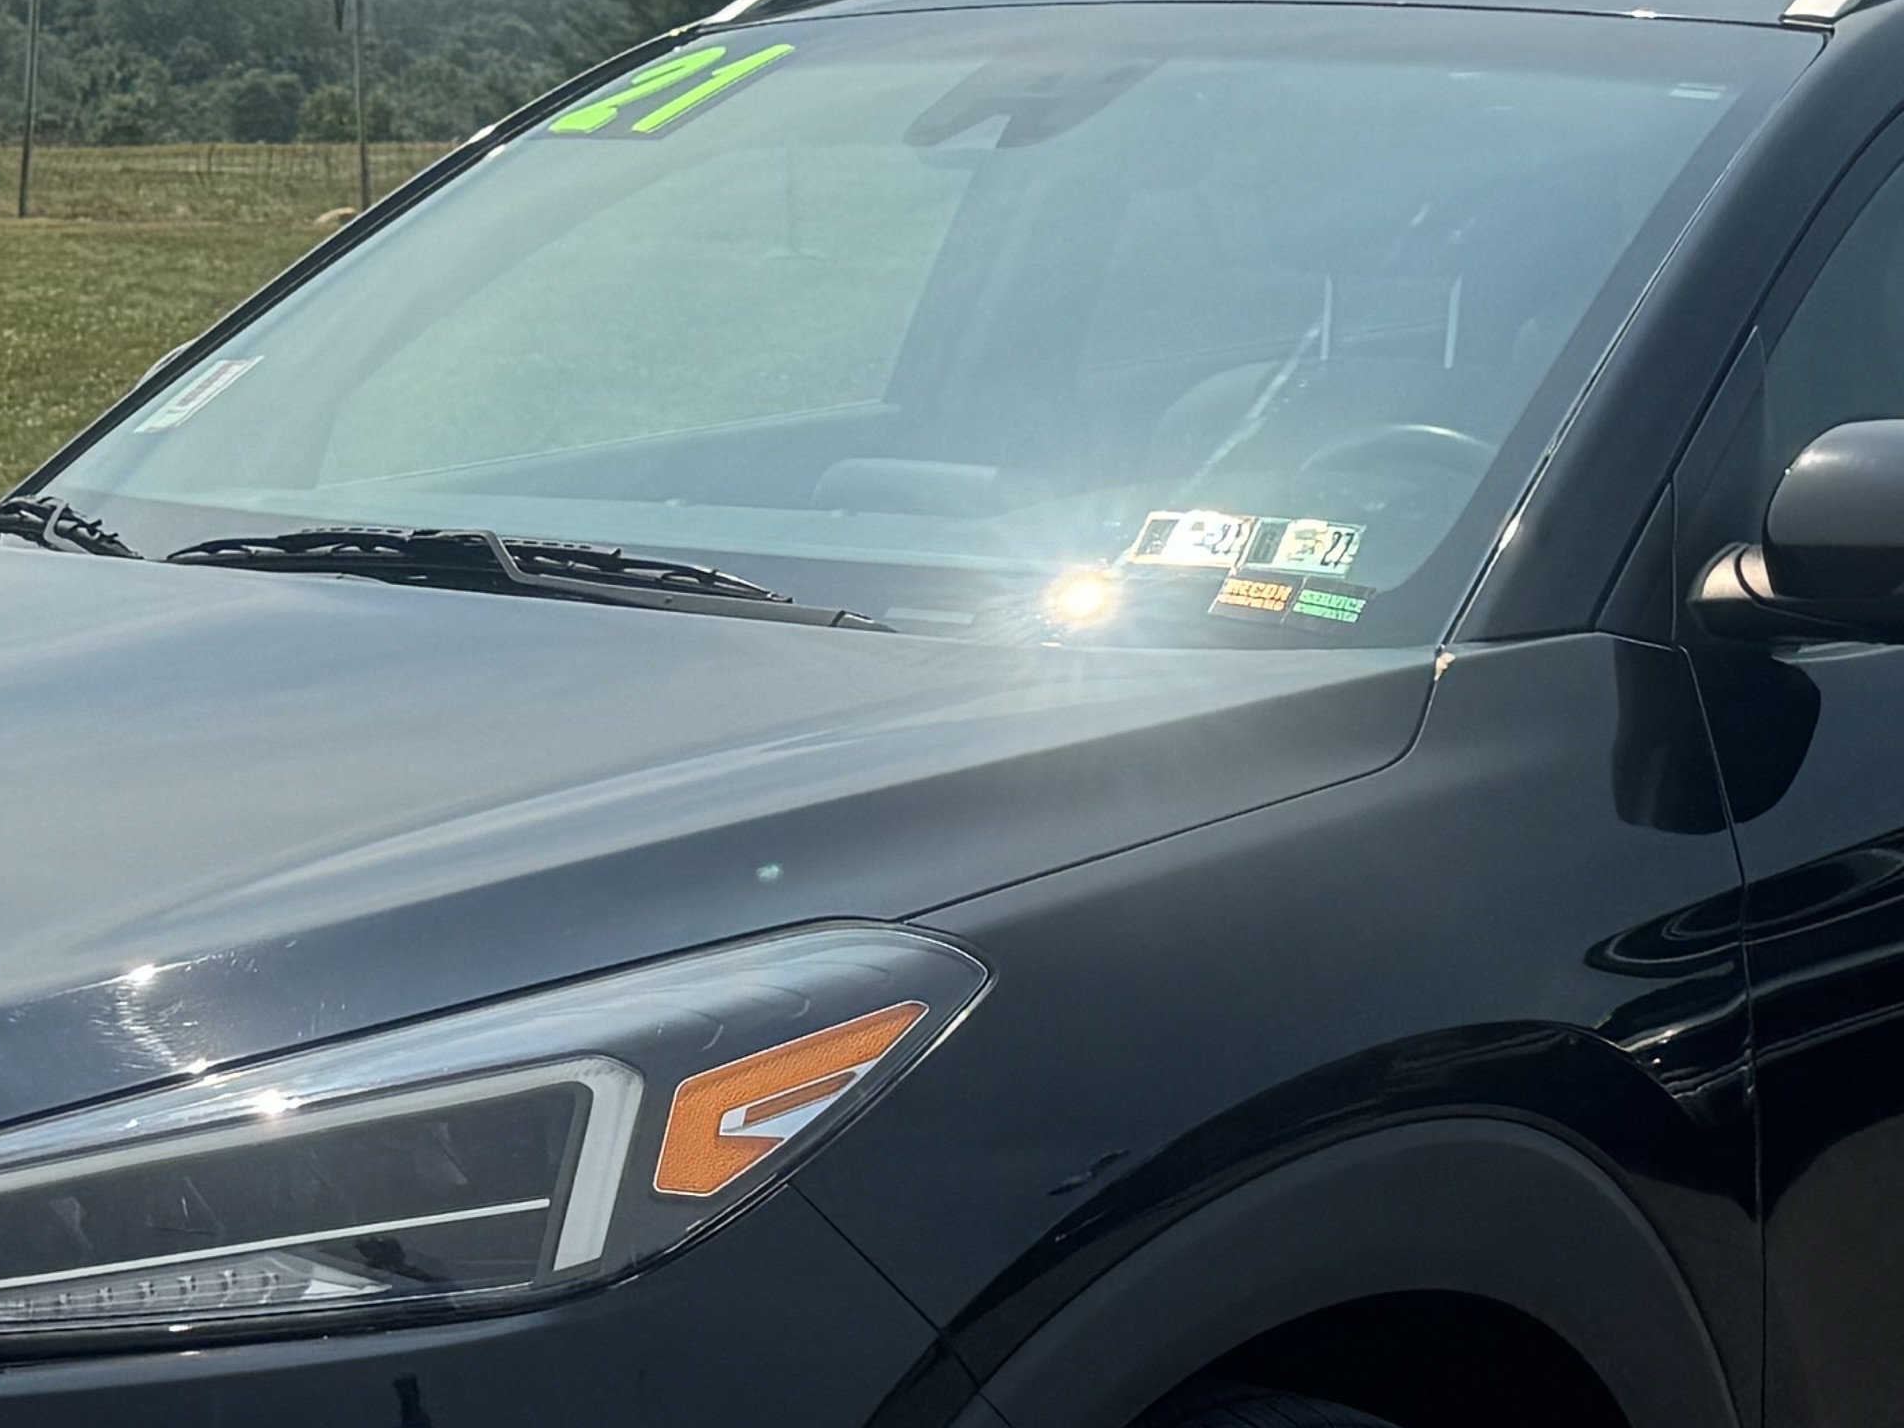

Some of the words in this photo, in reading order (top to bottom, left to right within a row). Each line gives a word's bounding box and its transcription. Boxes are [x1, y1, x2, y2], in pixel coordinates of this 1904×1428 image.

[549, 43, 795, 134] 21
[1320, 530, 1354, 567] 27
[1224, 578, 1293, 601] RECON
